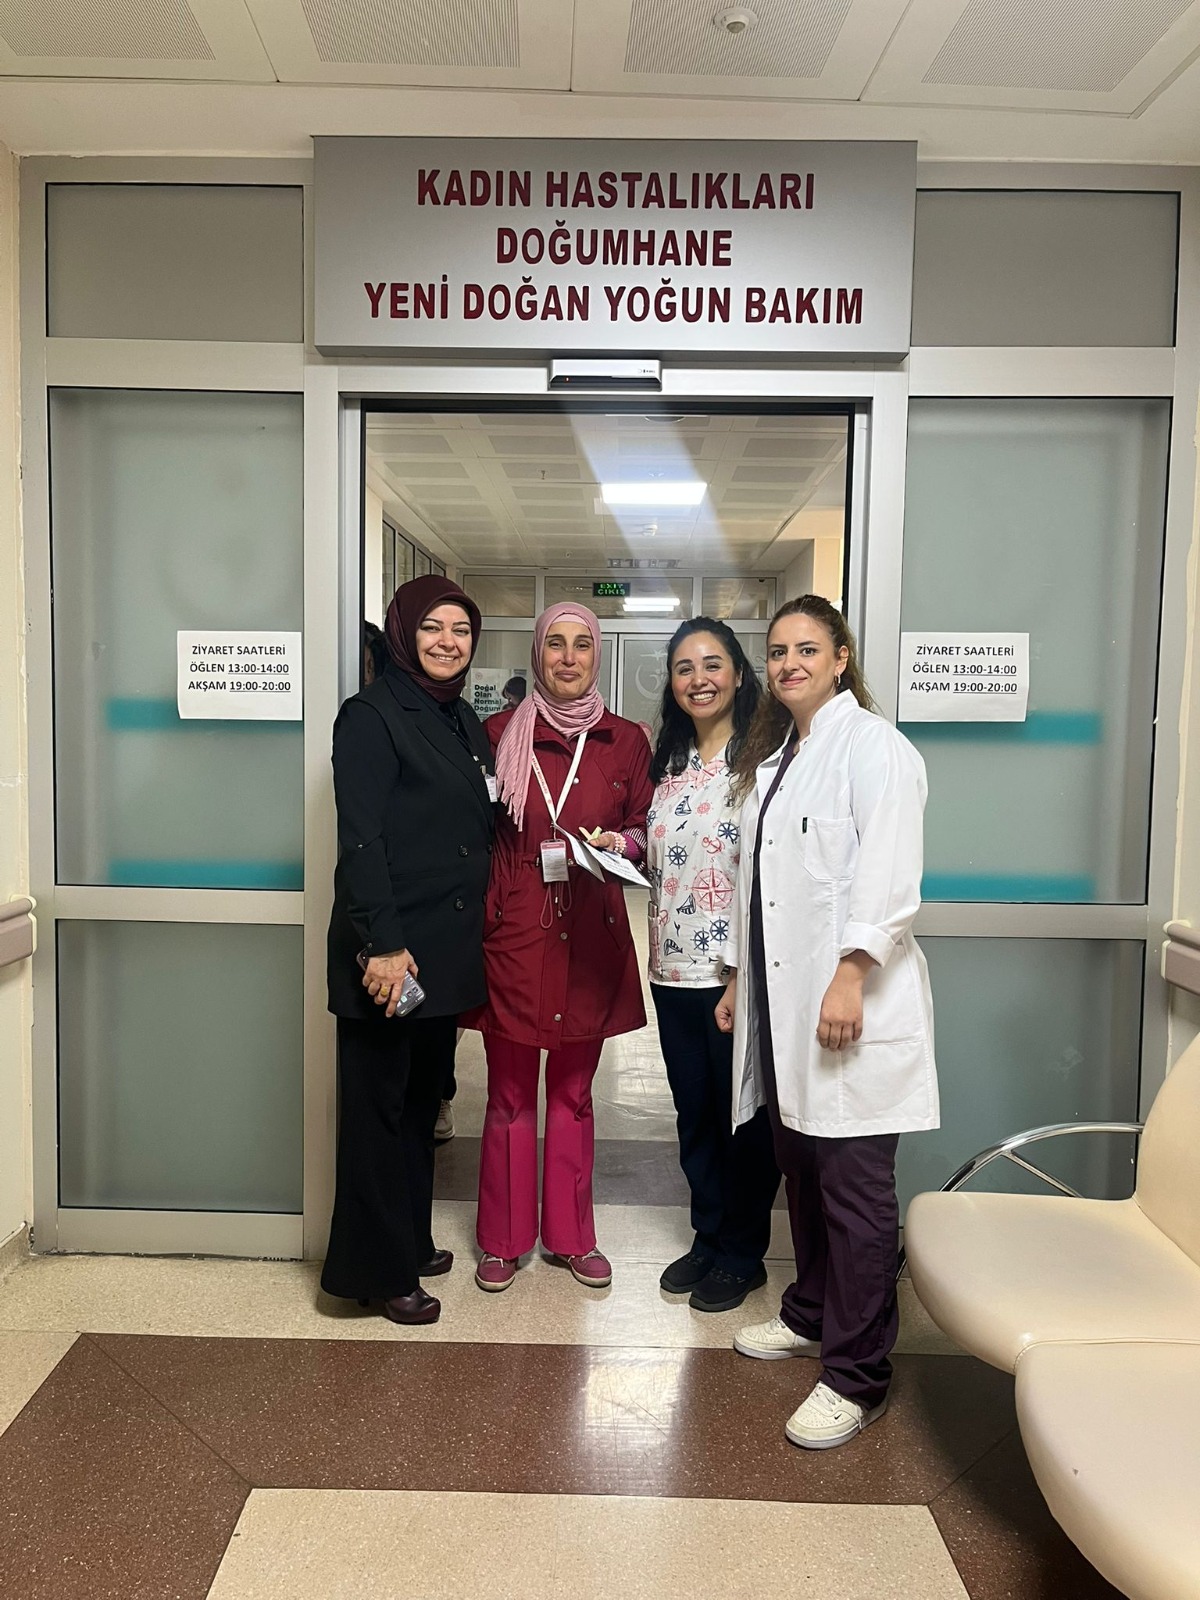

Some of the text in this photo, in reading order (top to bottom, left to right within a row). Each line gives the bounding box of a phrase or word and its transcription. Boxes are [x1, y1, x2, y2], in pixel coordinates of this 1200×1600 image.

[416, 168, 815, 210] KADIN HASTALIKLARI
[496, 219, 733, 268] DOĞUMHANE
[364, 273, 863, 325] YENİ DOĞAN YOĞUN BAKIM
[192, 643, 286, 655] ZİYARET SAATLERİ
[916, 643, 1014, 656] ZİYARET SAATLERİ
[189, 661, 289, 675] ÖĞLEN 13:00-14:00
[912, 661, 1017, 676] ÖĞLEN 13:00-14:00
[187, 681, 291, 692] AKŞAM 19:00-20:00
[474, 684, 496, 692] Doğal
[910, 681, 1018, 694] AKŞAM 19:00-20:00
